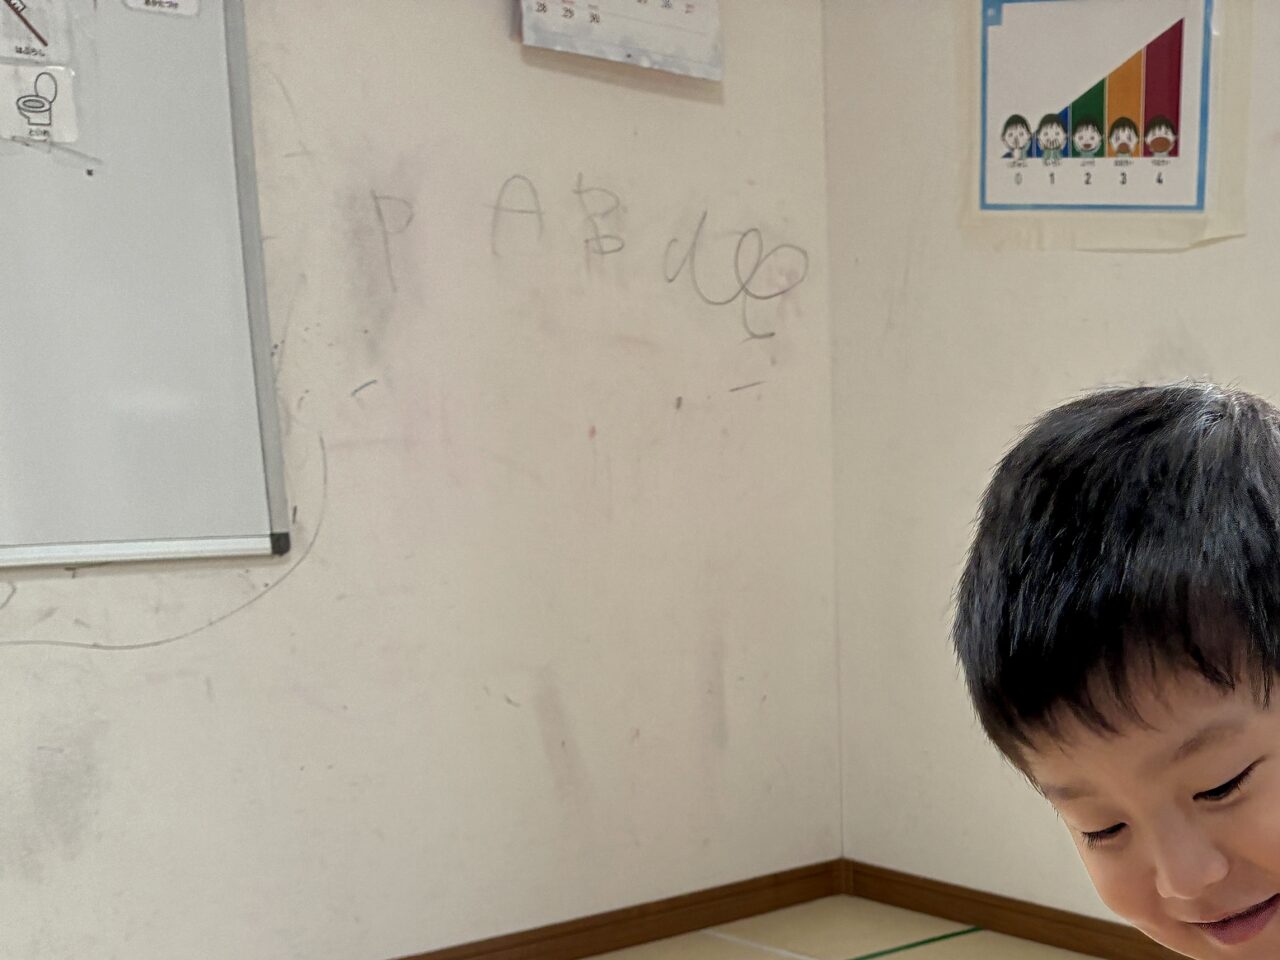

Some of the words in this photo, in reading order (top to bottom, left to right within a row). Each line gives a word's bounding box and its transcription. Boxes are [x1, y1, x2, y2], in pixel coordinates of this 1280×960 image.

[1014, 172, 1023, 186] 0
[1049, 172, 1055, 185] 1
[1084, 171, 1092, 185] 2
[1119, 171, 1127, 185] 3
[1155, 171, 1164, 185] 4
[482, 174, 545, 257] A
